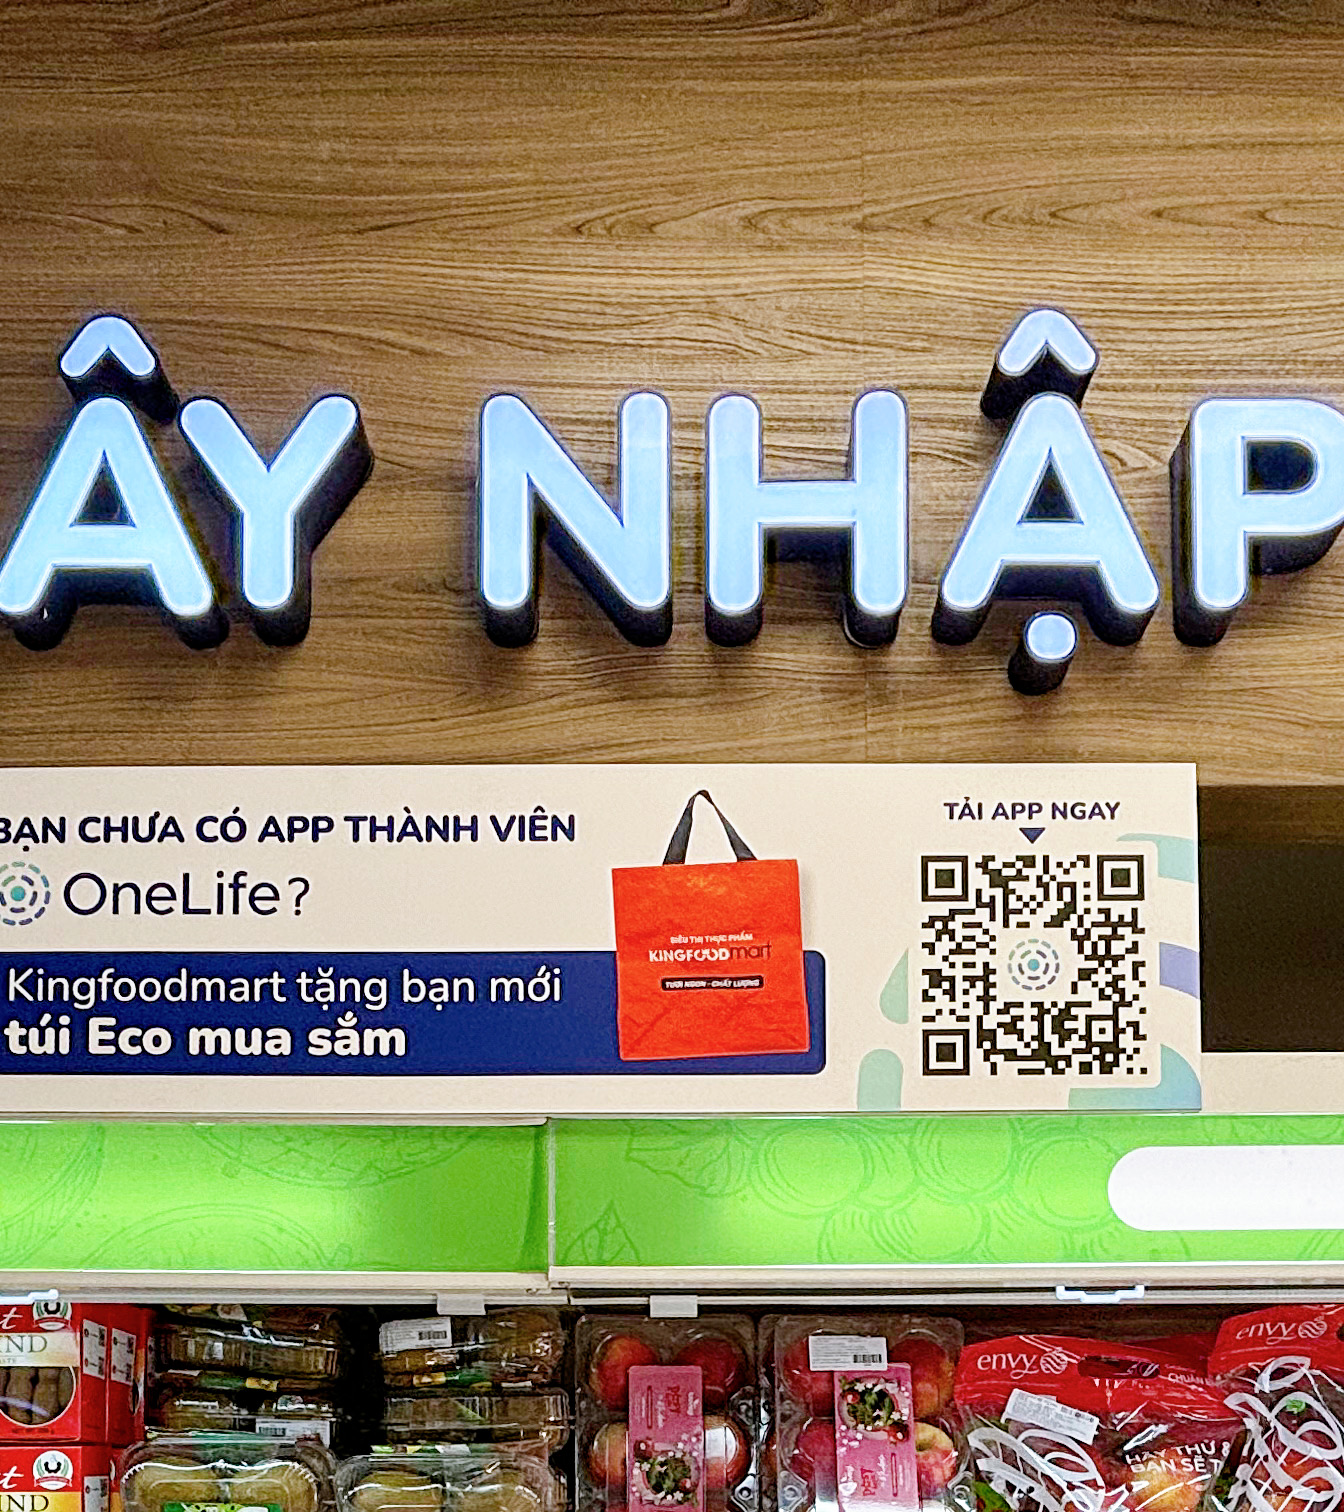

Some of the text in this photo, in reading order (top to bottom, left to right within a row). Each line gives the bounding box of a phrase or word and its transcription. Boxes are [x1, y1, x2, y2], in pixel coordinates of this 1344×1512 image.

[78, 811, 185, 843] CHƯA
[196, 809, 247, 843] CÓ
[258, 815, 335, 843] APP
[344, 808, 480, 843] THÀNH
[490, 807, 576, 843] VIÊN
[942, 798, 1122, 823] TẢI APP NGAY
[7, 967, 563, 1013] Kingfoodmart tặng bạn mới
[4, 1011, 407, 1058] túi Eco mua sắm
[1236, 1321, 1298, 1345] envy
[977, 1352, 1039, 1379] envy
